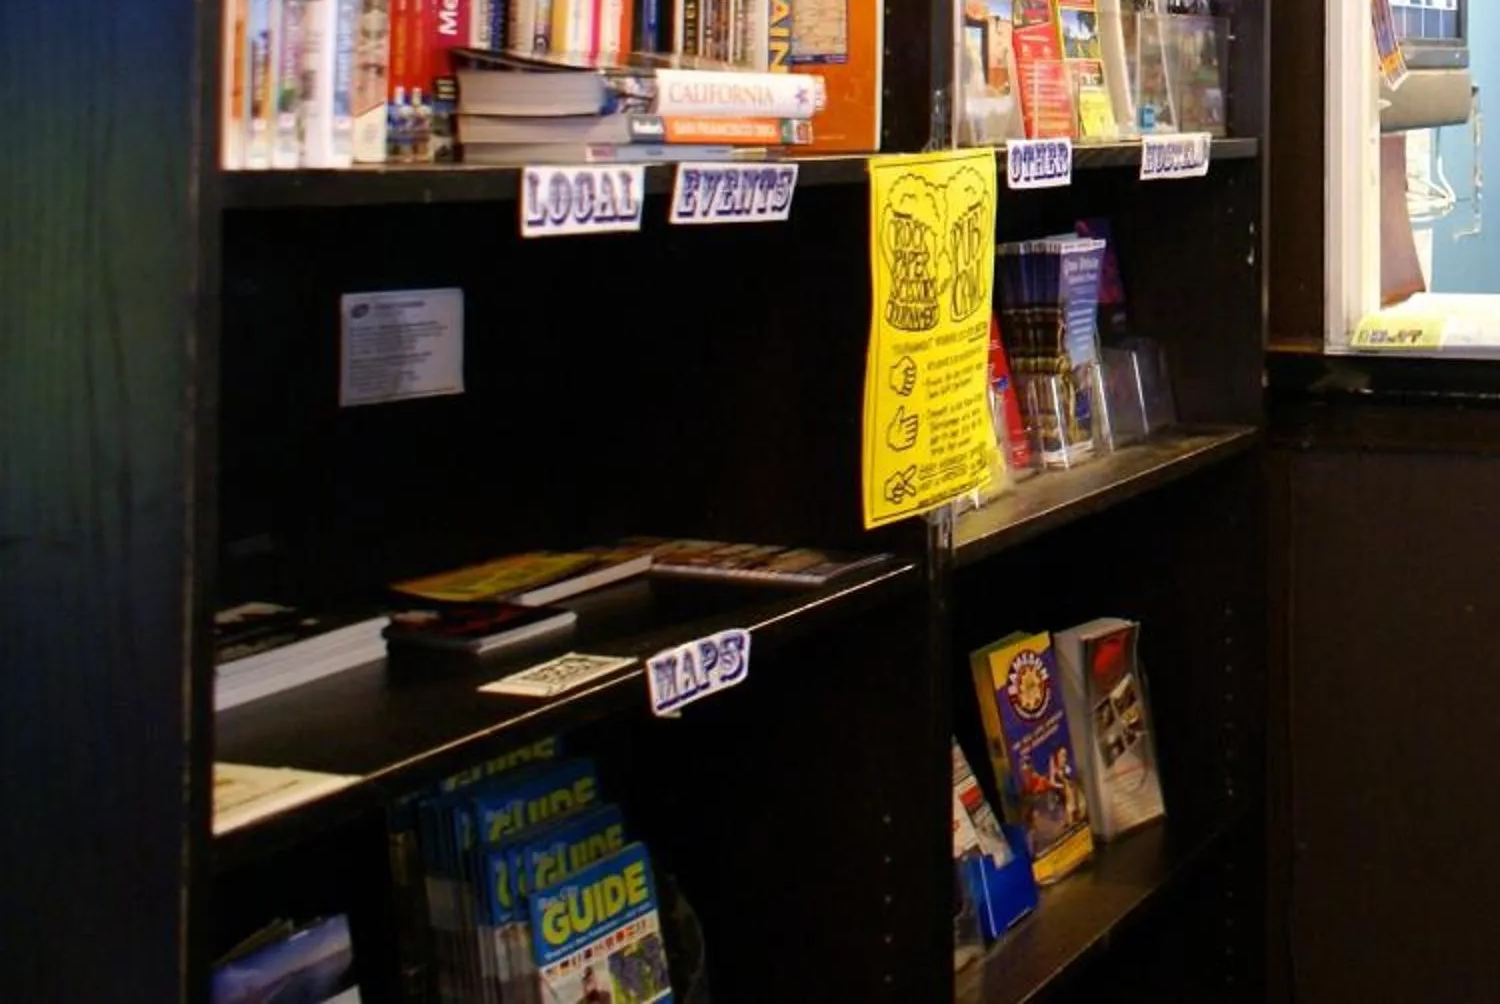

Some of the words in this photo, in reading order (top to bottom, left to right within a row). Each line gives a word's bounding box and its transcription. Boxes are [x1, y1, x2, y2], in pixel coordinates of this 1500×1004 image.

[667, 81, 775, 105] CALIFORNIA
[1010, 143, 1070, 183] OTHER
[526, 170, 641, 225] LOCAL
[676, 168, 794, 218] EVENTS
[653, 634, 746, 710] MAPS
[541, 860, 649, 945] GUIDE
